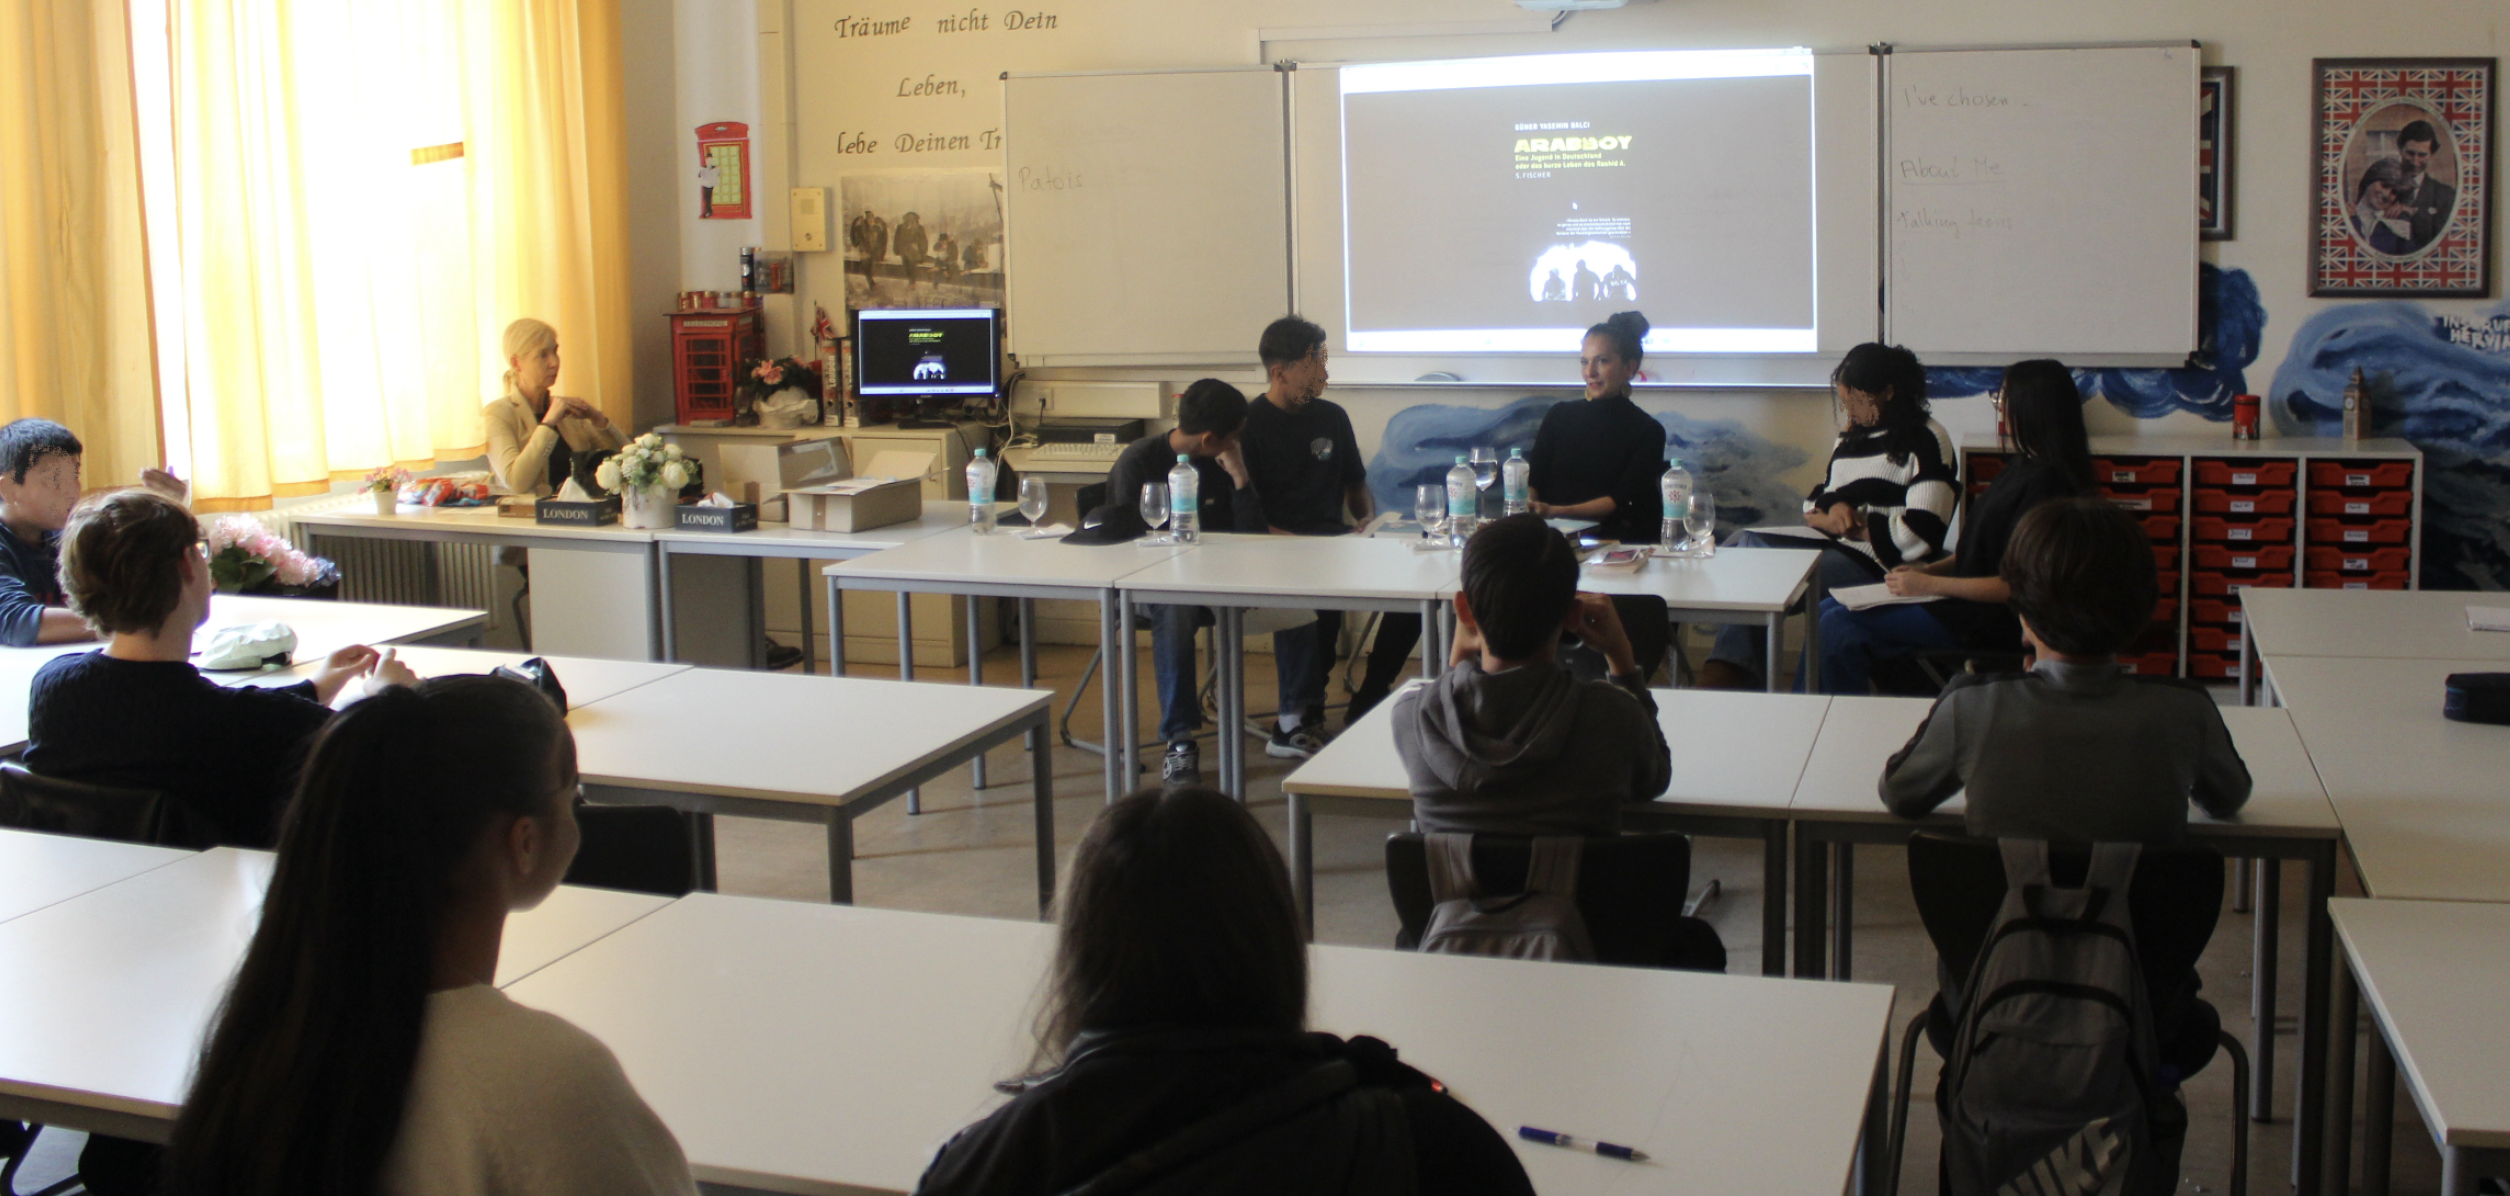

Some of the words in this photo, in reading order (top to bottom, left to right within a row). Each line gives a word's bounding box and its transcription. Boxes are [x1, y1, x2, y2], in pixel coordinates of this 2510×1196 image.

[834, 15, 910, 38] Träume
[937, 8, 989, 33] nicht
[1004, 10, 1058, 31] Dein
[896, 74, 966, 98] Leben,
[1904, 84, 1939, 108] I've
[1947, 86, 2009, 107] chosen
[1514, 122, 1538, 131] GÜNER
[1540, 121, 1569, 130] YASEMIN
[1570, 121, 1590, 129] BALCI
[837, 131, 877, 154] lebe
[895, 132, 970, 153] Deinen
[1514, 135, 1633, 153] ARABBOY
[1515, 154, 1529, 162] Eine
[1531, 154, 1553, 162] Jugend
[1562, 152, 1602, 160] Deutschland
[1900, 155, 1960, 179] About
[1973, 156, 2005, 177] Me
[542, 508, 588, 520] LONDON
[681, 513, 725, 526] LONDON
